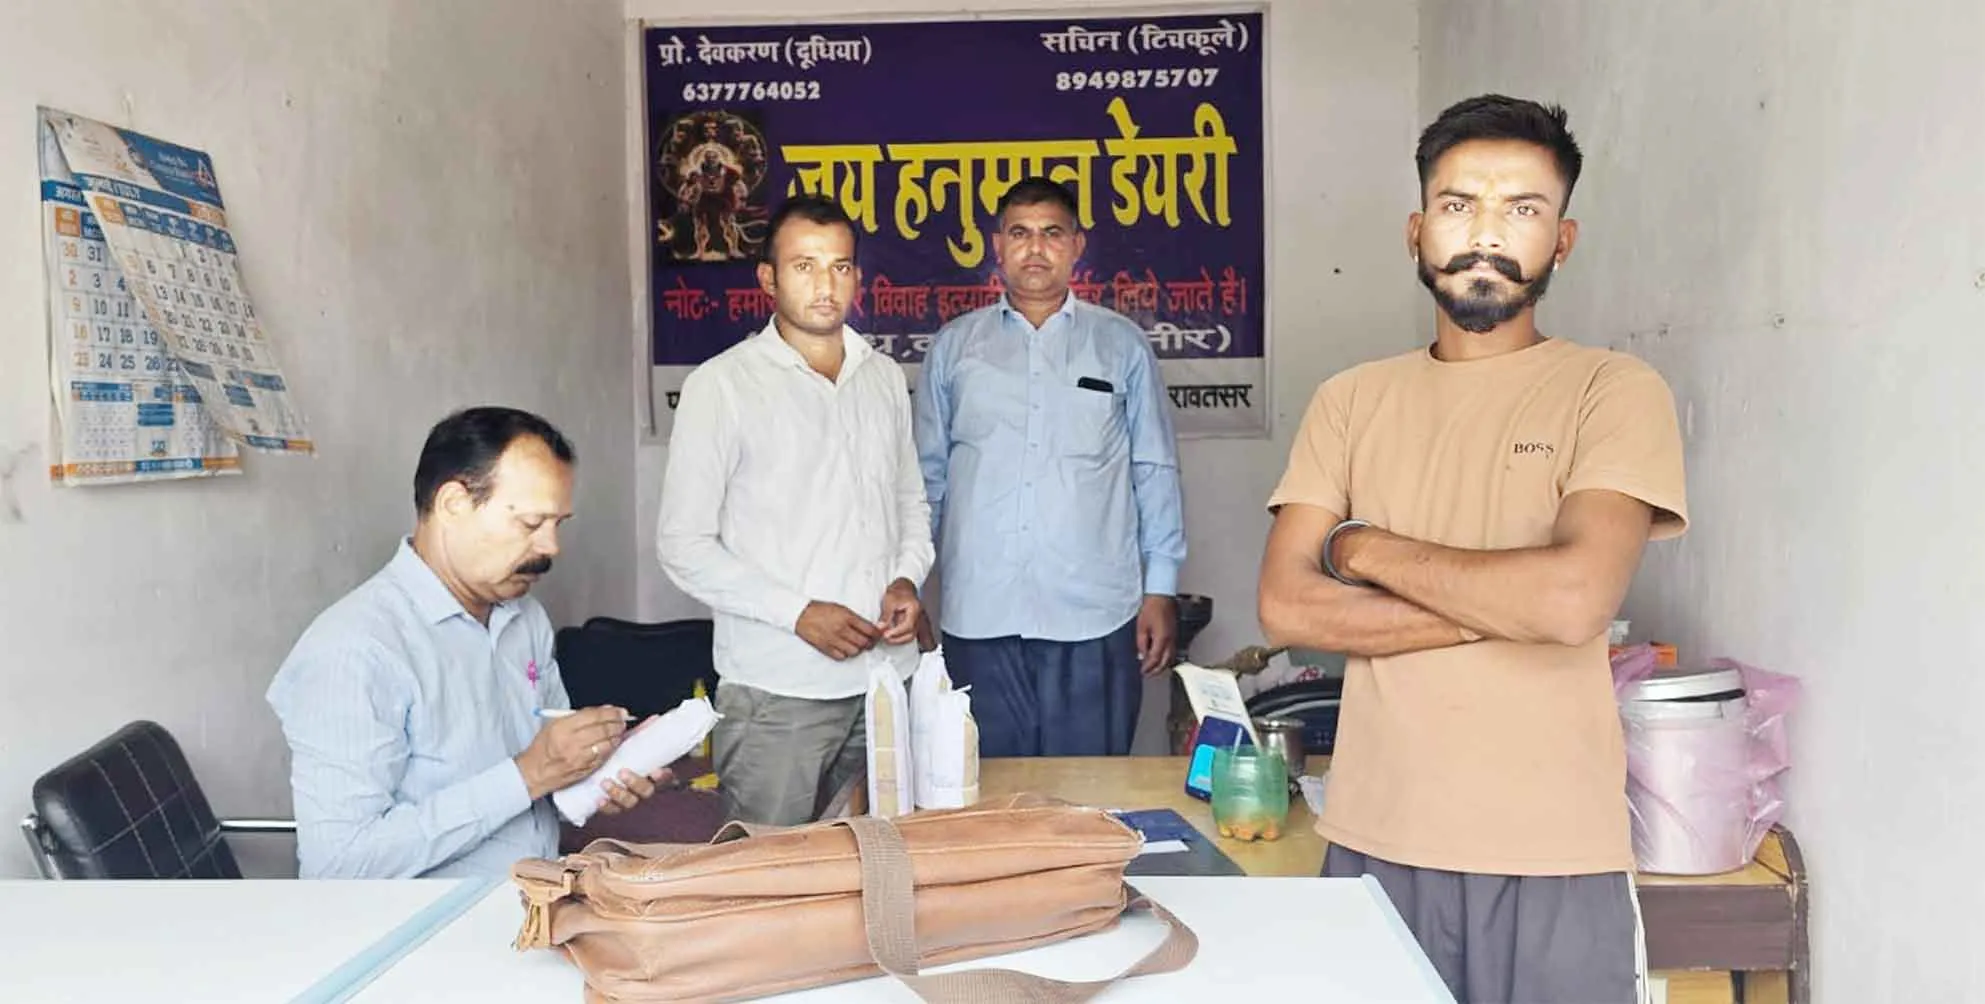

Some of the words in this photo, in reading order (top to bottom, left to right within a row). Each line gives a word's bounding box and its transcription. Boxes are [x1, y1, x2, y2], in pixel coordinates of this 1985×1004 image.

[1040, 26, 1121, 52] सचिन
[1128, 20, 1249, 55] (टिचकूले)
[658, 36, 692, 66] प्रो.
[697, 35, 780, 65] देवकरण
[785, 35, 872, 69] (दूधिया)
[1056, 68, 1219, 90] 8949875707
[683, 82, 821, 101] 6377764052
[781, 144, 884, 233] जय
[1105, 97, 1238, 228] डेयरी
[87, 246, 101, 262] 31
[69, 269, 77, 286] 2
[93, 273, 101, 289] 3
[116, 276, 126, 292] 4
[872, 274, 931, 321] विवाह
[1112, 267, 1160, 314] लिये
[1165, 266, 1216, 314] जाते
[94, 299, 107, 316] 10
[117, 301, 129, 318] 11
[97, 326, 110, 342] 17
[119, 328, 133, 344] 18
[143, 330, 158, 345] 19
[98, 353, 113, 369] 24
[119, 354, 136, 370] 25
[1168, 384, 1253, 409] रावतसर
[1514, 442, 1554, 454] BOSS
